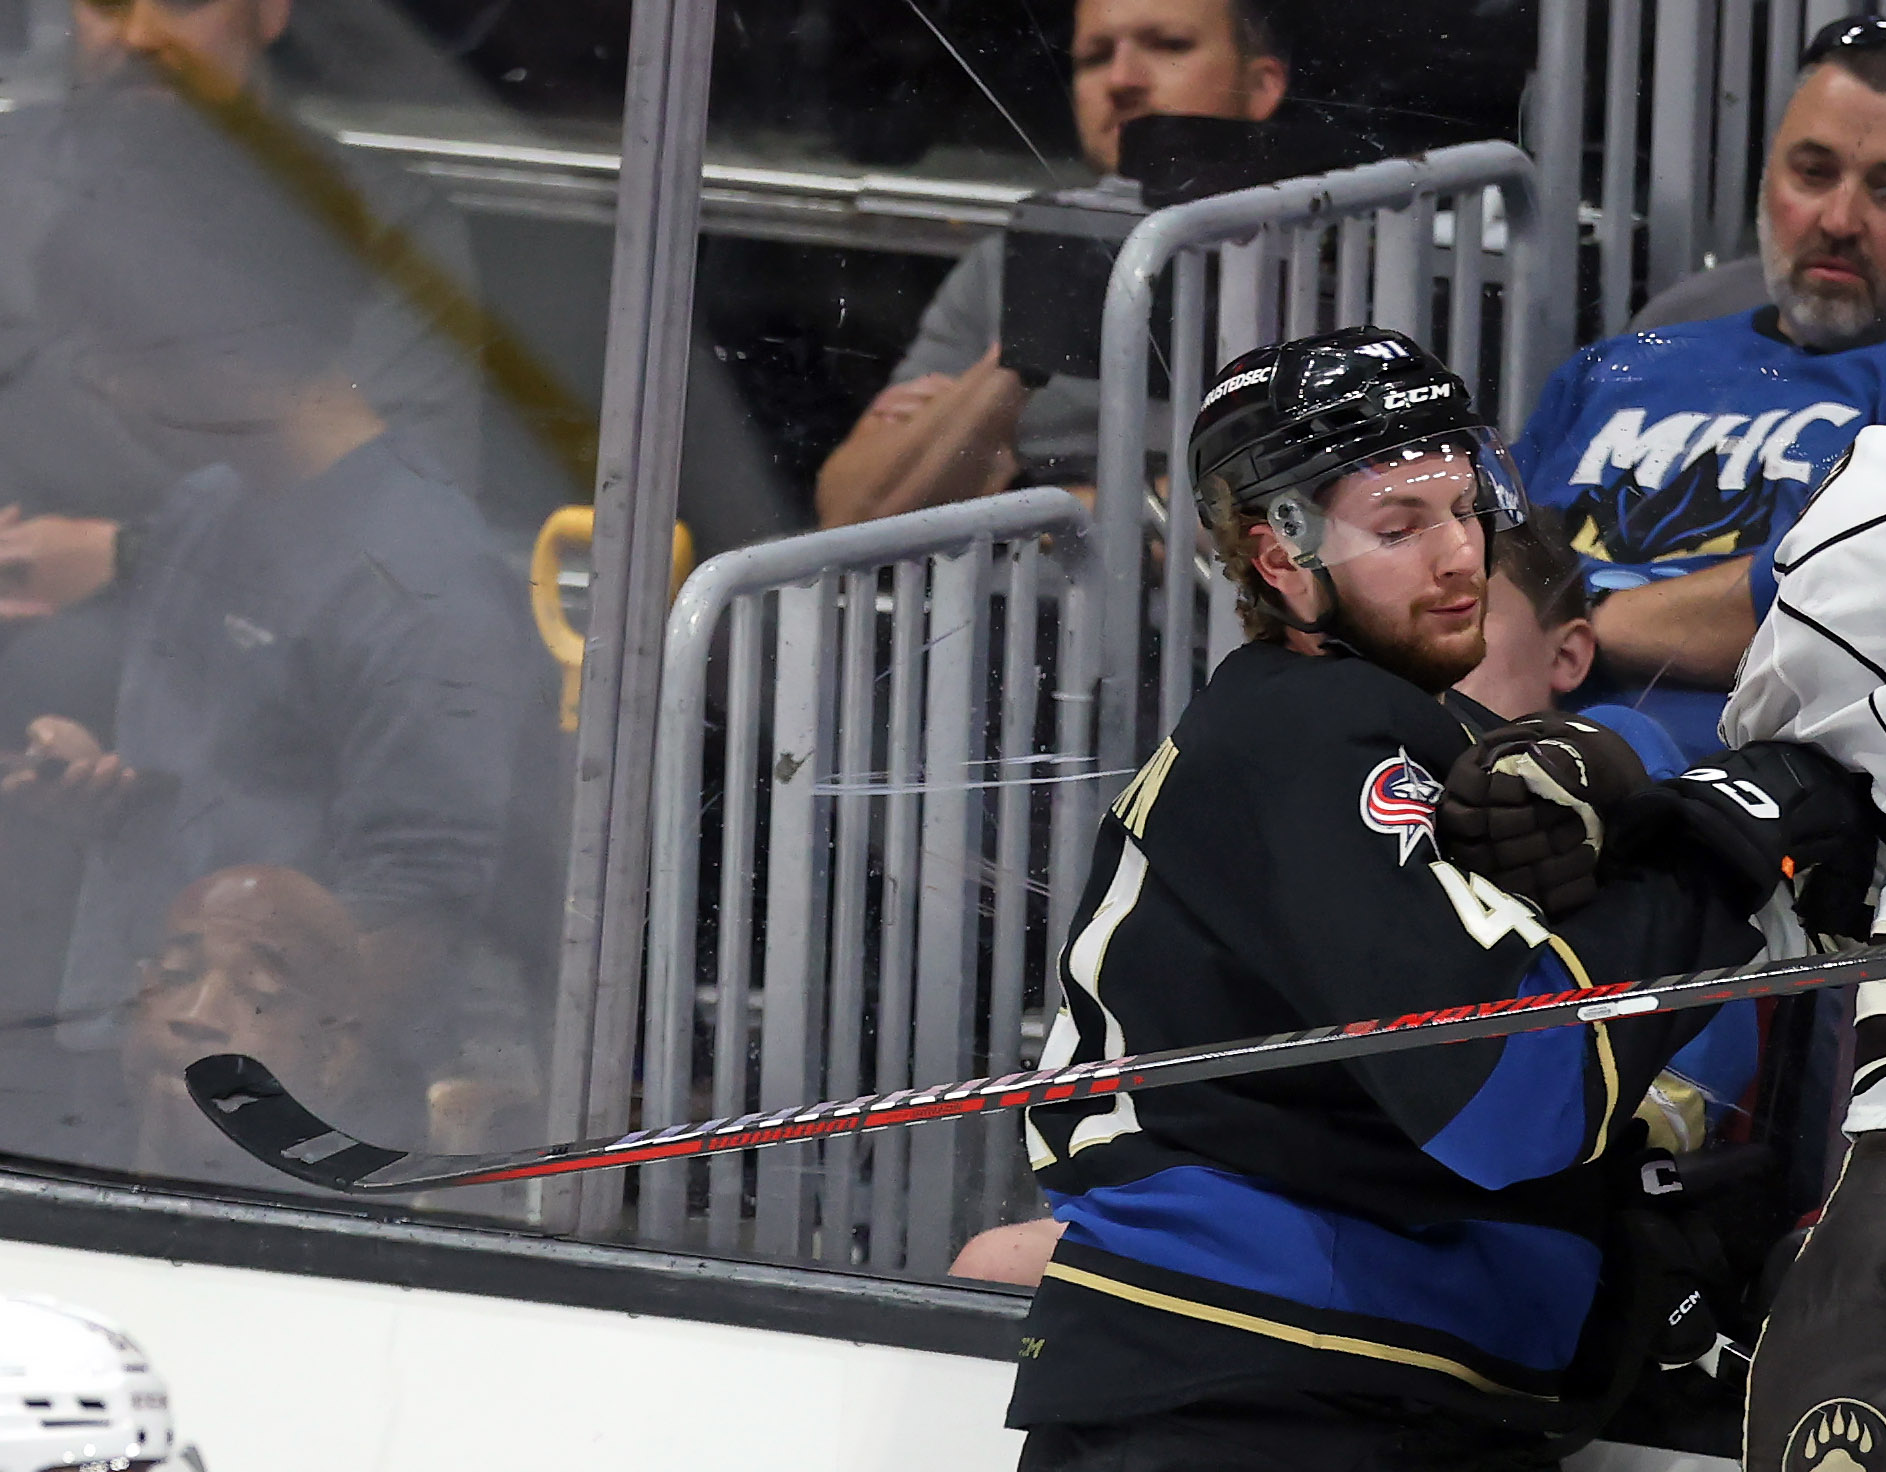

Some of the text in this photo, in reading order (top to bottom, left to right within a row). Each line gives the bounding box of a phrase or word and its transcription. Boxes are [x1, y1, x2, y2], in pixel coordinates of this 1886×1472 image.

[1383, 383, 1450, 411] CCM
[1569, 402, 1861, 491] MHC
[1668, 1290, 1701, 1326] CCM
